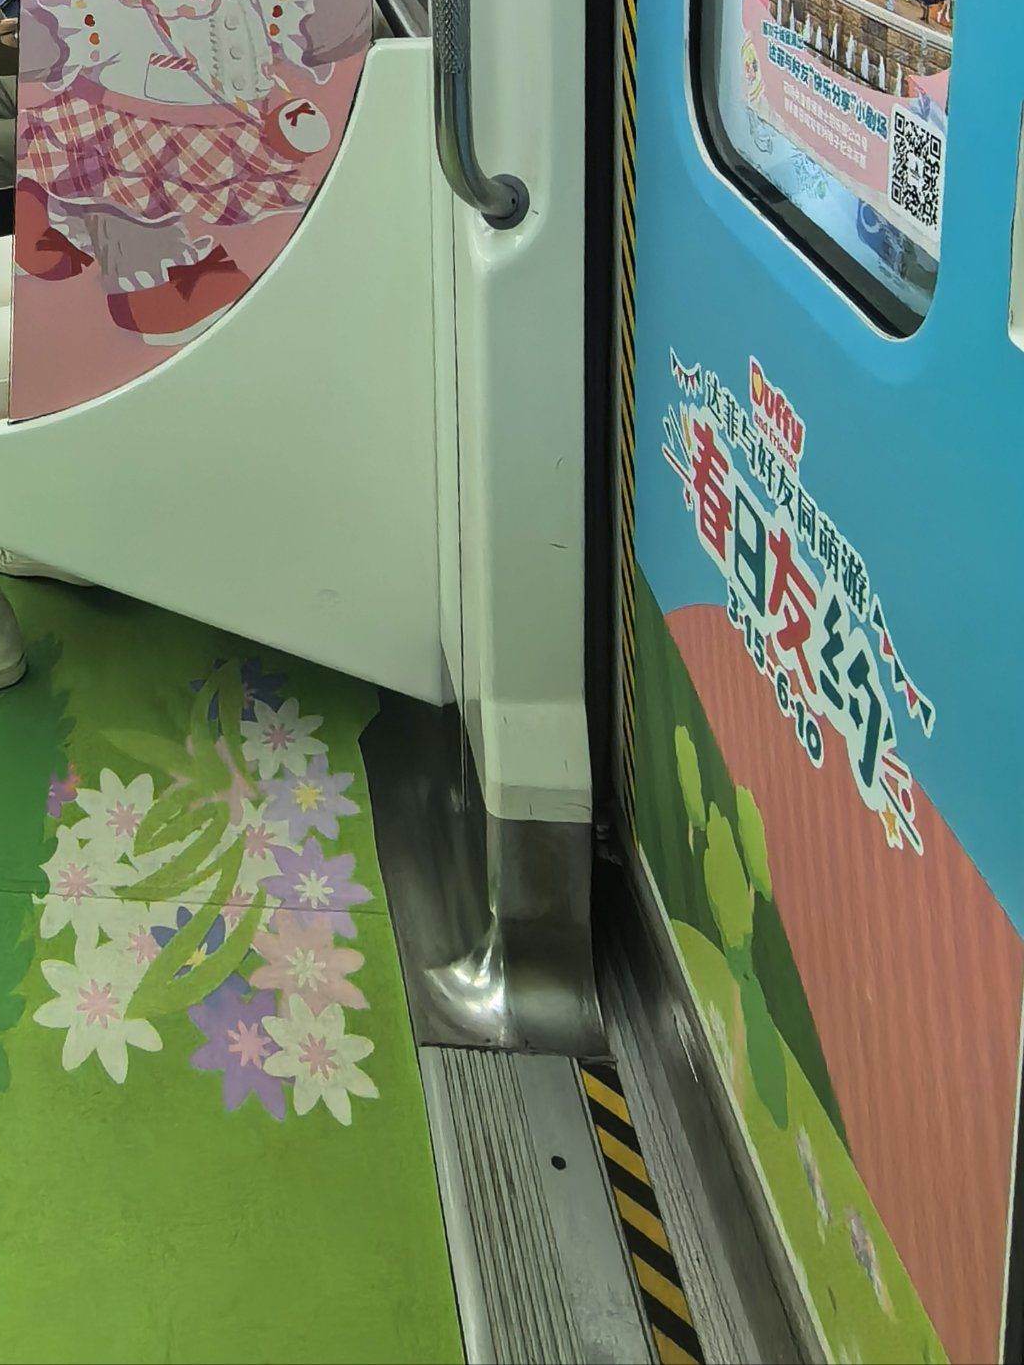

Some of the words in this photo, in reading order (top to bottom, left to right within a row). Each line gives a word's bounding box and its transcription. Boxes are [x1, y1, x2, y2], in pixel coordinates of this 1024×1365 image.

[706, 378, 867, 614] 达菲与好友同萌游
[751, 361, 804, 455] Duffy
[692, 418, 882, 788] 春日友约
